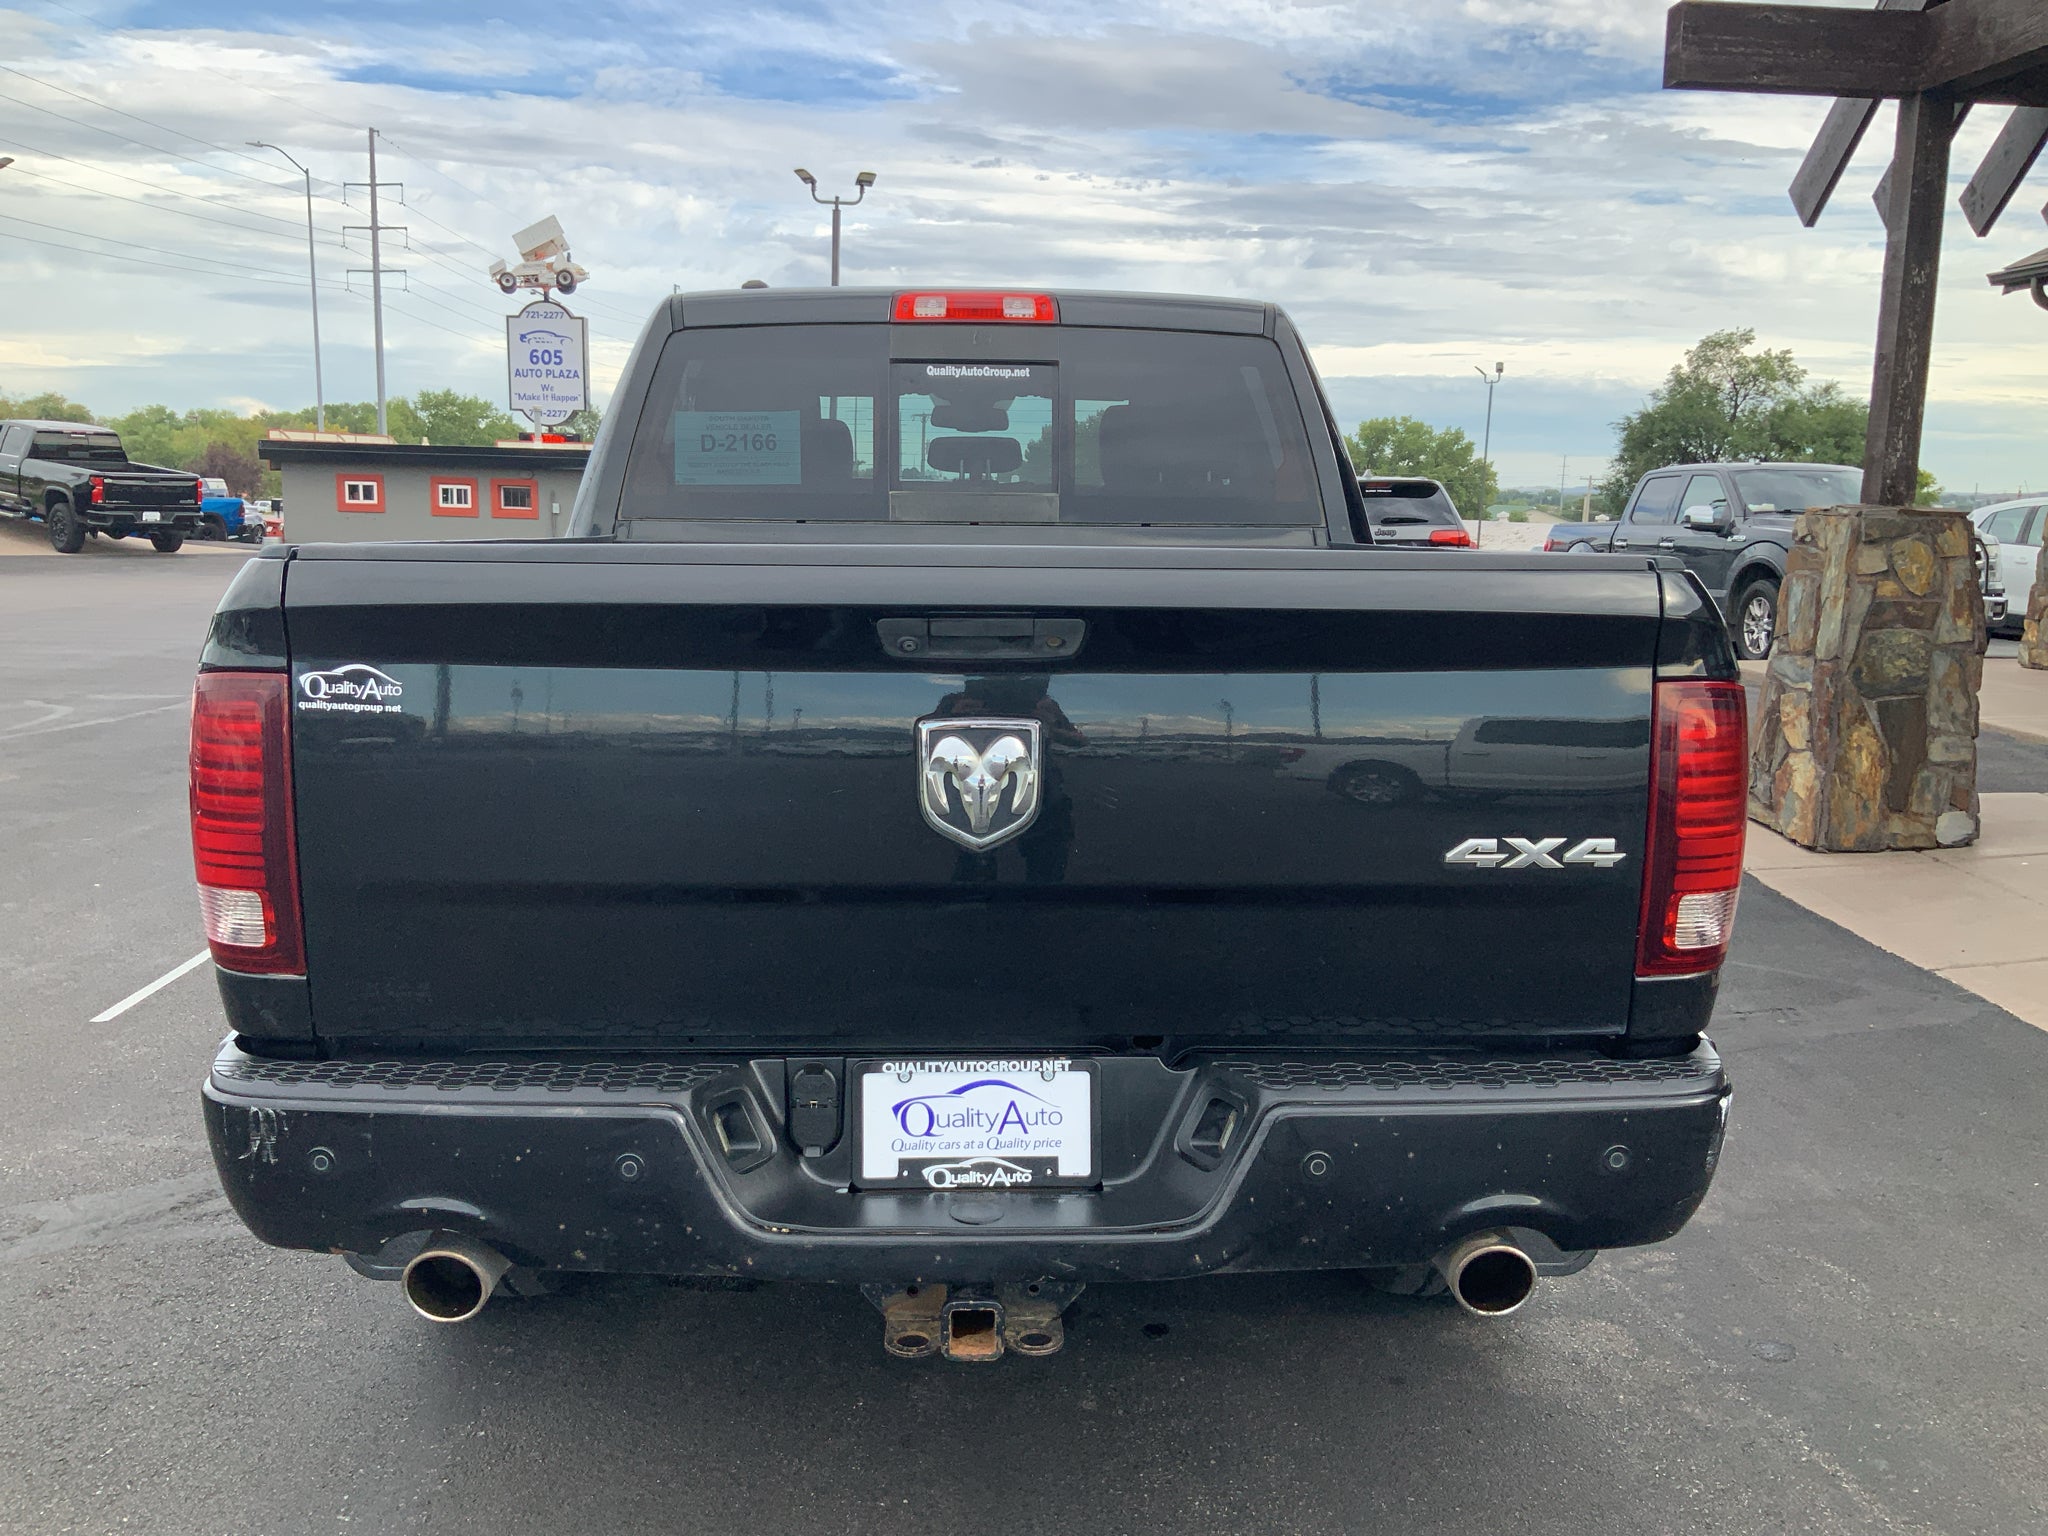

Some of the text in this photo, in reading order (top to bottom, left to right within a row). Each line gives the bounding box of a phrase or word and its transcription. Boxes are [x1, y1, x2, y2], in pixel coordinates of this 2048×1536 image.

[525, 311, 564, 319] 721-2277
[529, 349, 563, 365] 605
[514, 368, 580, 379] AUTO PLAZA
[926, 365, 1030, 378] QualityAutoGroup.net
[540, 384, 554, 392] We
[542, 393, 549, 401] It
[529, 409, 568, 418] 71-2277
[706, 423, 772, 431] VEHICLE DEALER
[701, 433, 777, 452] D-2166
[1374, 528, 1397, 537] Jeep
[1444, 837, 1627, 868] 4X4
[882, 1060, 1072, 1073] QUALITYAUTOGROUP.NET
[891, 1136, 1062, 1152] Quality cars at a Quality price
